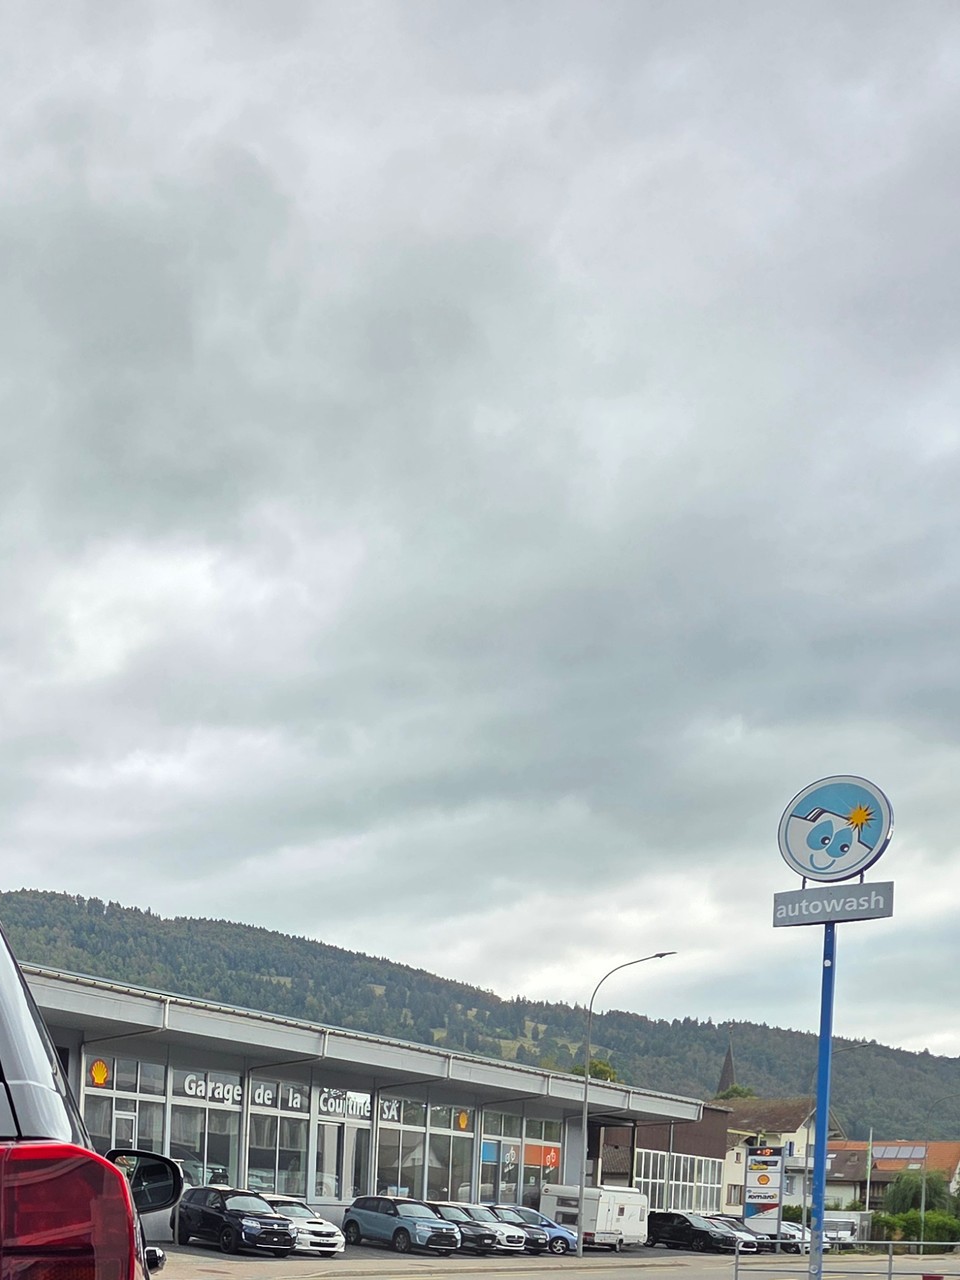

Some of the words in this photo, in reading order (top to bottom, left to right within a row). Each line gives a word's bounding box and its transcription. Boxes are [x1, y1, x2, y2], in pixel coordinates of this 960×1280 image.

[775, 891, 884, 918] autowash
[184, 1074, 242, 1105] Garage
[254, 1084, 272, 1105] de
[288, 1087, 301, 1108] la
[383, 1101, 399, 1120] SA
